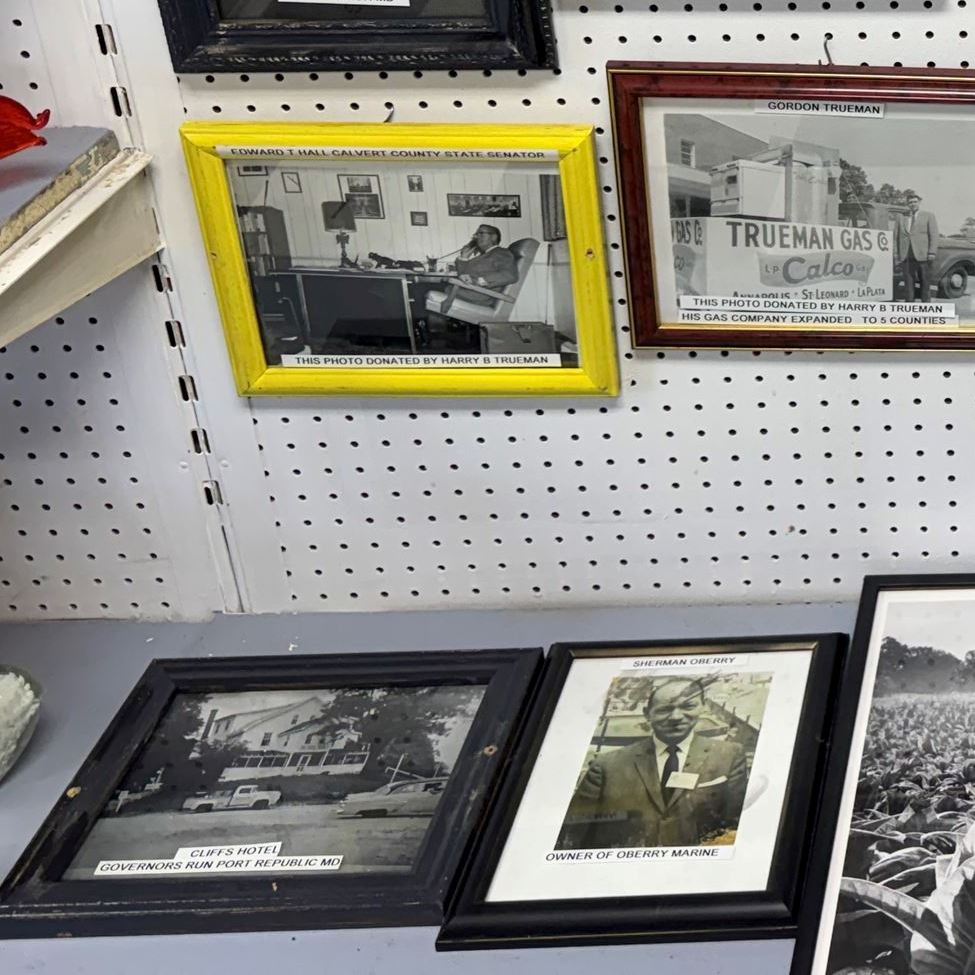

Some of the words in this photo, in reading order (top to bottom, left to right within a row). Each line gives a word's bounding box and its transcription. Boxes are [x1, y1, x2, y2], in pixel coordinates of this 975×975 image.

[768, 101, 820, 111] GORDON
[824, 103, 880, 114] TRUEMAN
[725, 220, 834, 251] TRUEMAN
[840, 230, 873, 252] GAS
[782, 253, 854, 284] Calco
[295, 356, 321, 365] THIS
[324, 357, 363, 366] PHOTO
[366, 357, 421, 366] DONATED
[424, 357, 438, 365] BY
[441, 356, 480, 365] HARRY
[483, 356, 491, 364] B
[495, 356, 548, 364] TRUEMAN
[633, 659, 687, 668] SHERMAN
[690, 657, 736, 665] OBERRY
[190, 848, 234, 858] CLIFFS
[237, 845, 279, 855] HOTEL
[545, 852, 593, 861] OWNER
[596, 850, 613, 859] OF
[616, 849, 669, 859] OBERRY
[671, 848, 719, 857] MARINE
[100, 861, 182, 872] GOVERNORS
[185, 859, 213, 870] RUN
[216, 859, 252, 868] PORT
[254, 857, 318, 867] REPUBLIC
[320, 857, 340, 866] MD
